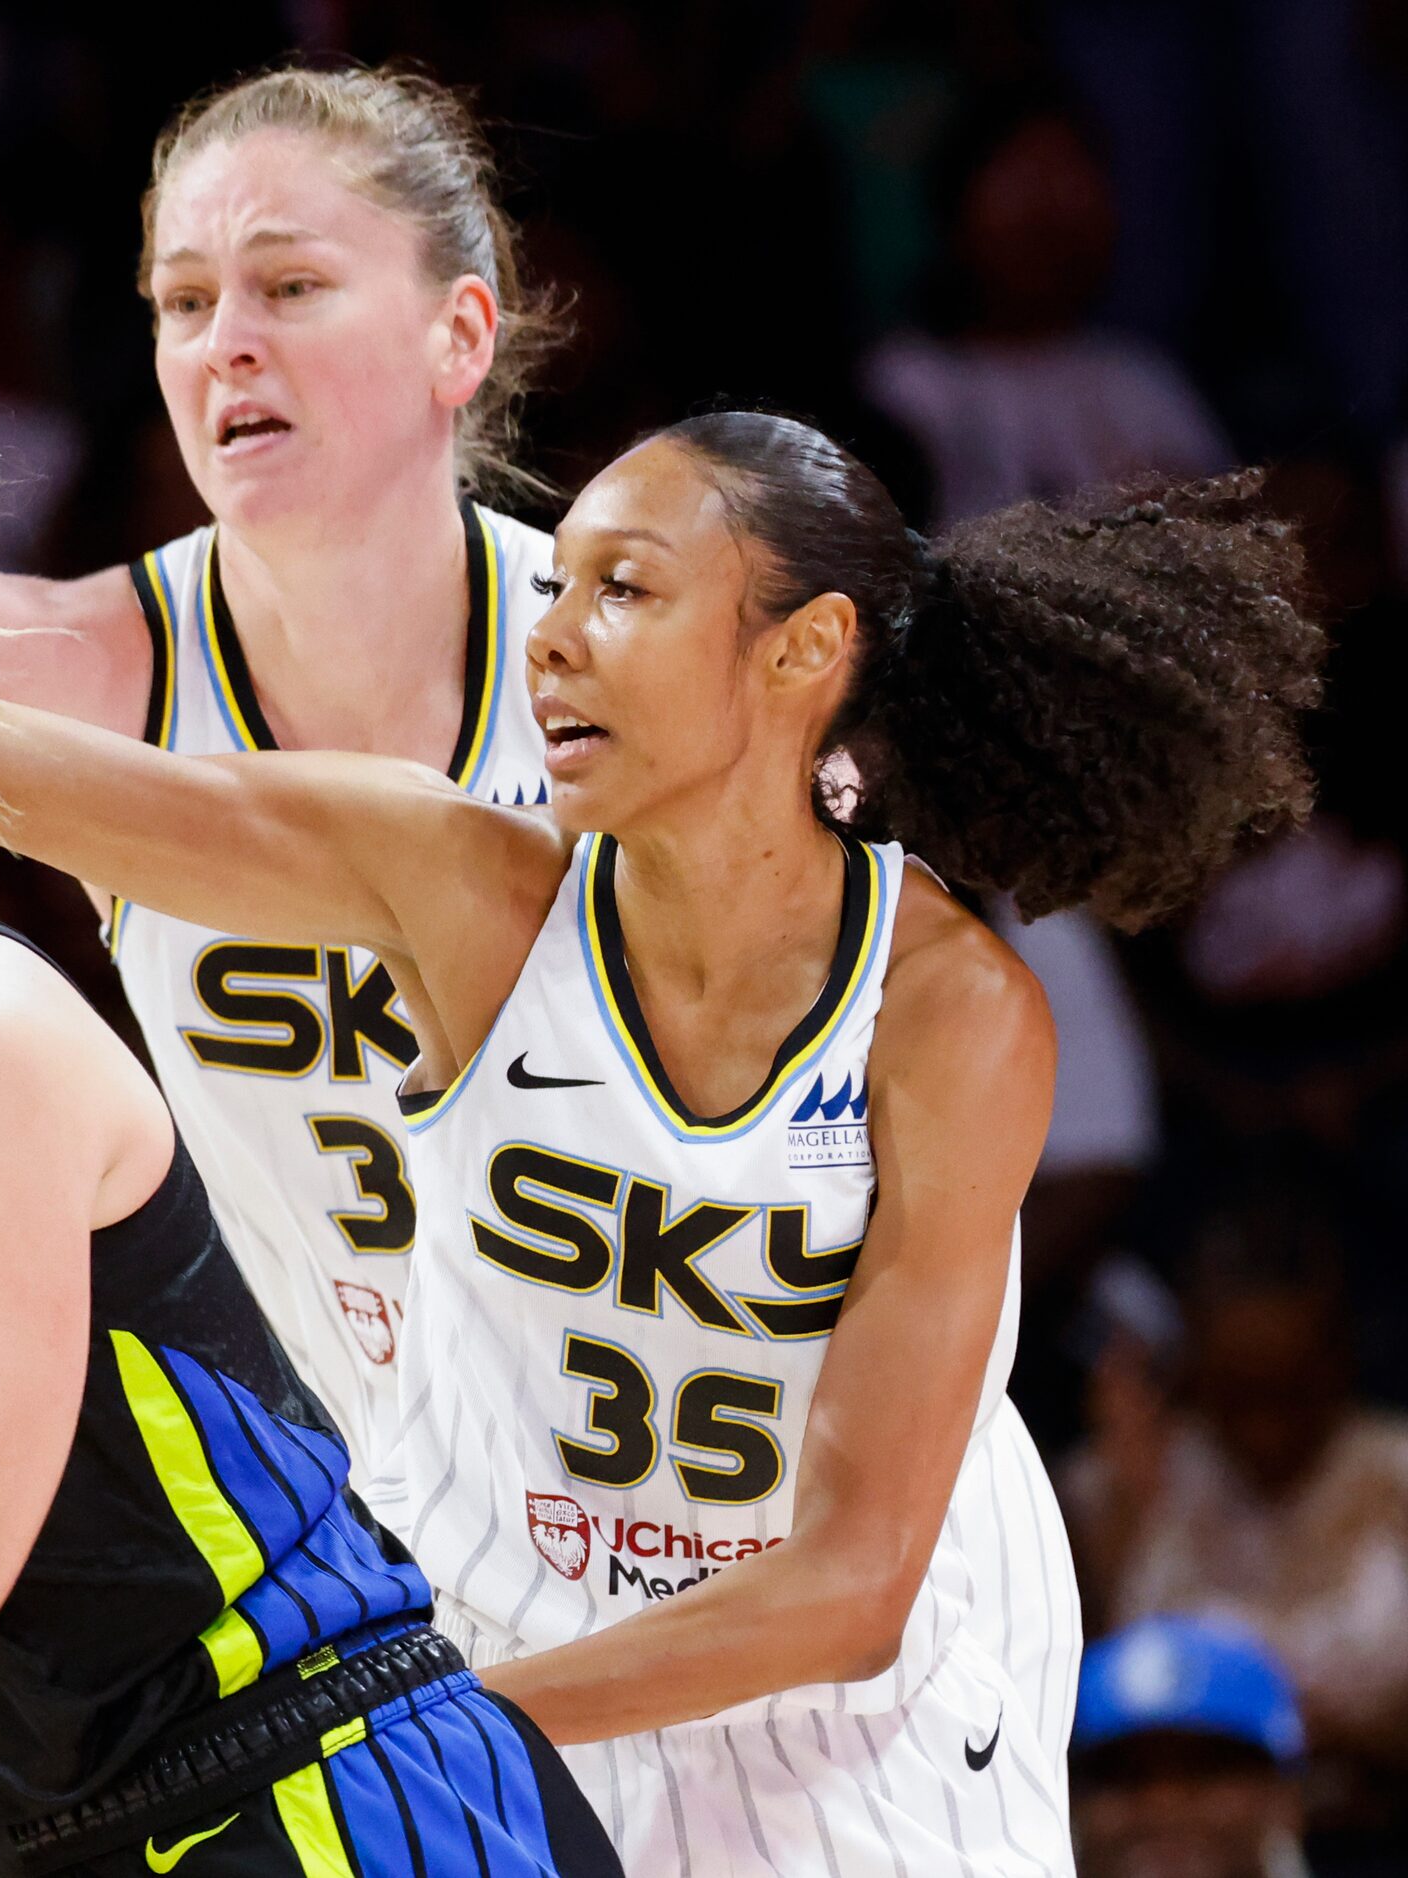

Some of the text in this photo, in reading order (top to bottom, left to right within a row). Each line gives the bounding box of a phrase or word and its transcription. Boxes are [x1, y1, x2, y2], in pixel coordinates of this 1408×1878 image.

[176, 936, 422, 1084] SK
[465, 1139, 864, 1343] SKY
[550, 1326, 787, 1507] 35
[591, 1515, 786, 1562] UChica
[608, 1554, 723, 1600] Med
